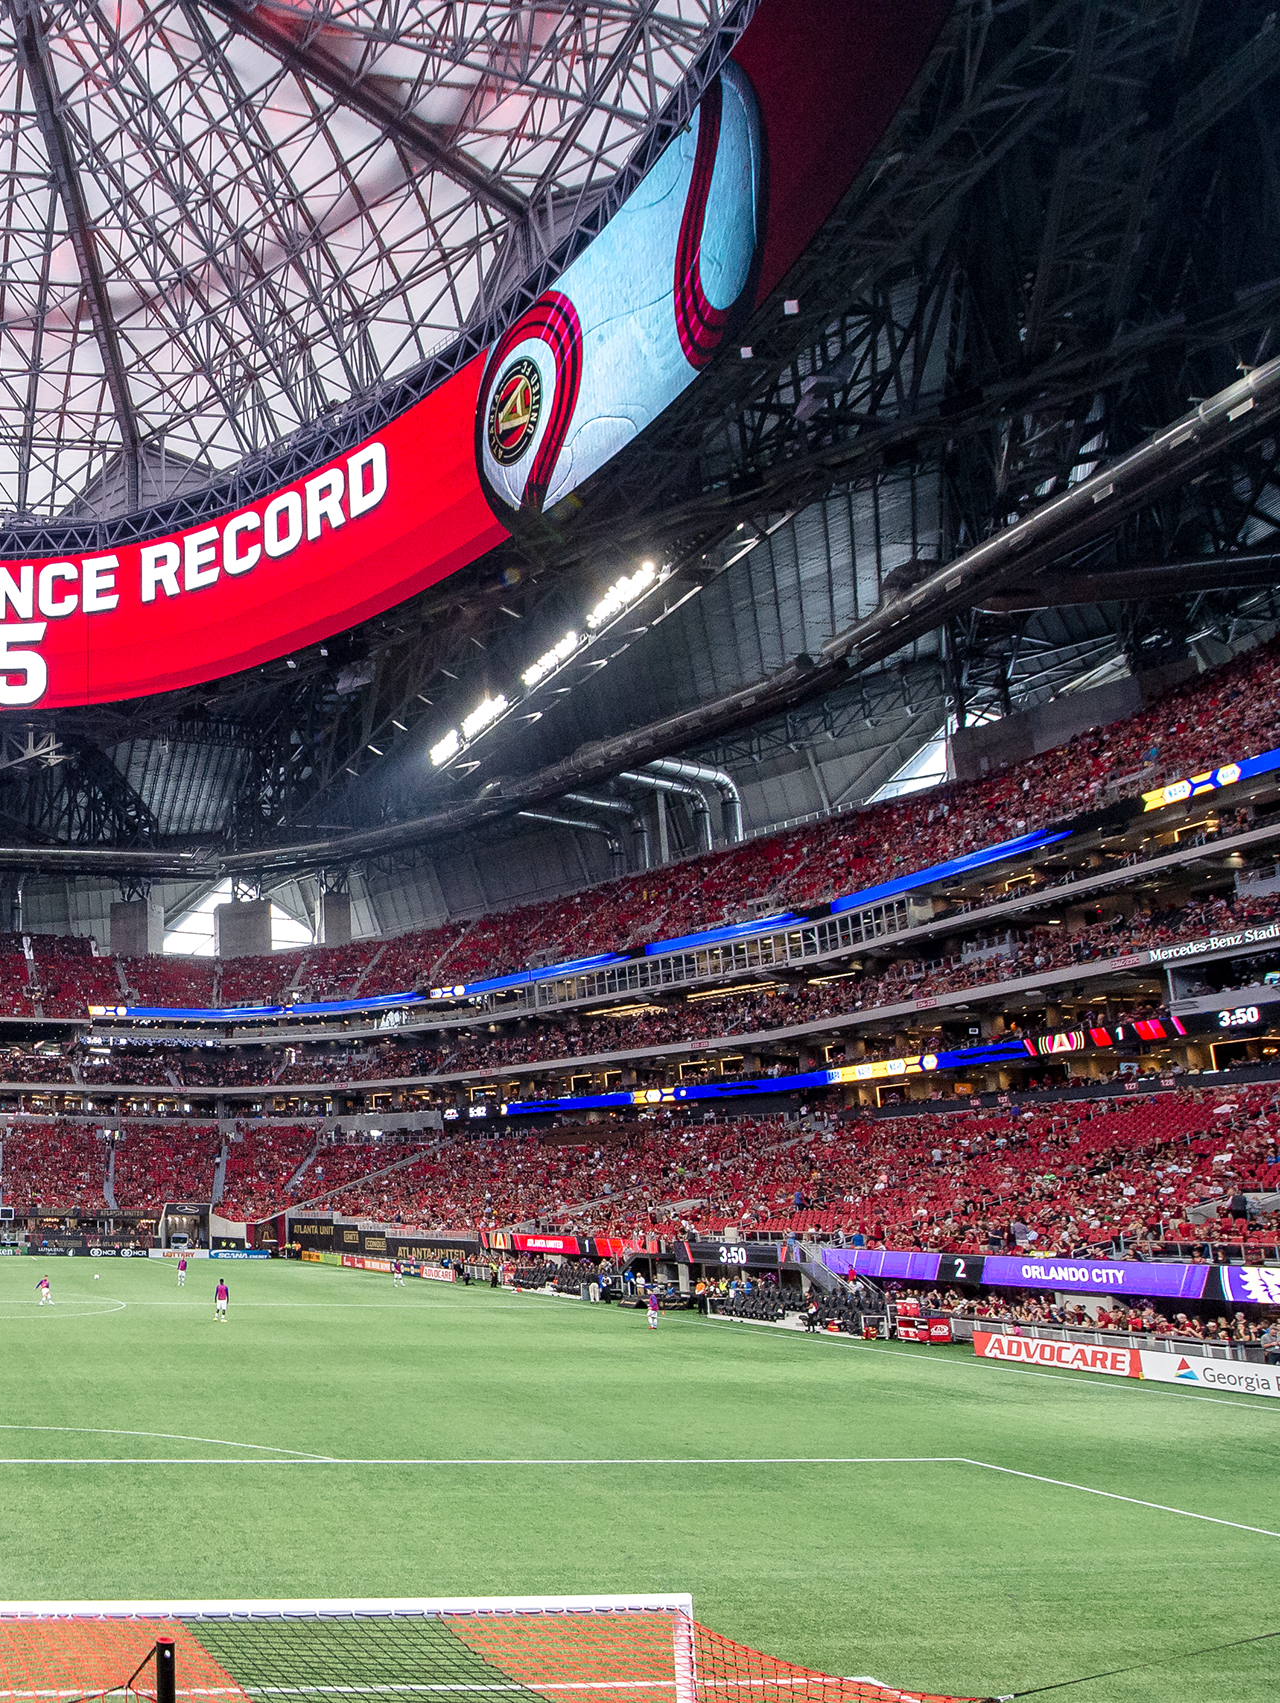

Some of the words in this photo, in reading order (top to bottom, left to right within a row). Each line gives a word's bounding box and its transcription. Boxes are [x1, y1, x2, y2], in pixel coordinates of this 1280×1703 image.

[527, 373, 540, 434] UNITED
[140, 442, 387, 603] RECORD
[1149, 933, 1243, 962] Mercedes-Benz
[1244, 924, 1280, 943] Stadi
[1218, 1006, 1260, 1027] 3:50
[1115, 1026, 1124, 1041] 1
[1125, 1082, 1136, 1090] 127
[294, 1224, 319, 1235] ATLANTA
[397, 1246, 433, 1259] ATLANTA
[584, 1239, 590, 1252] 1
[719, 1246, 747, 1264] 3:50
[424, 1268, 452, 1280] ADVOCARE
[954, 1258, 967, 1277] 2
[1021, 1264, 1089, 1282] ORLANDO
[1091, 1268, 1125, 1284] CITY
[988, 1338, 1127, 1372] ADVOCARE
[1203, 1367, 1271, 1391] Georgia
